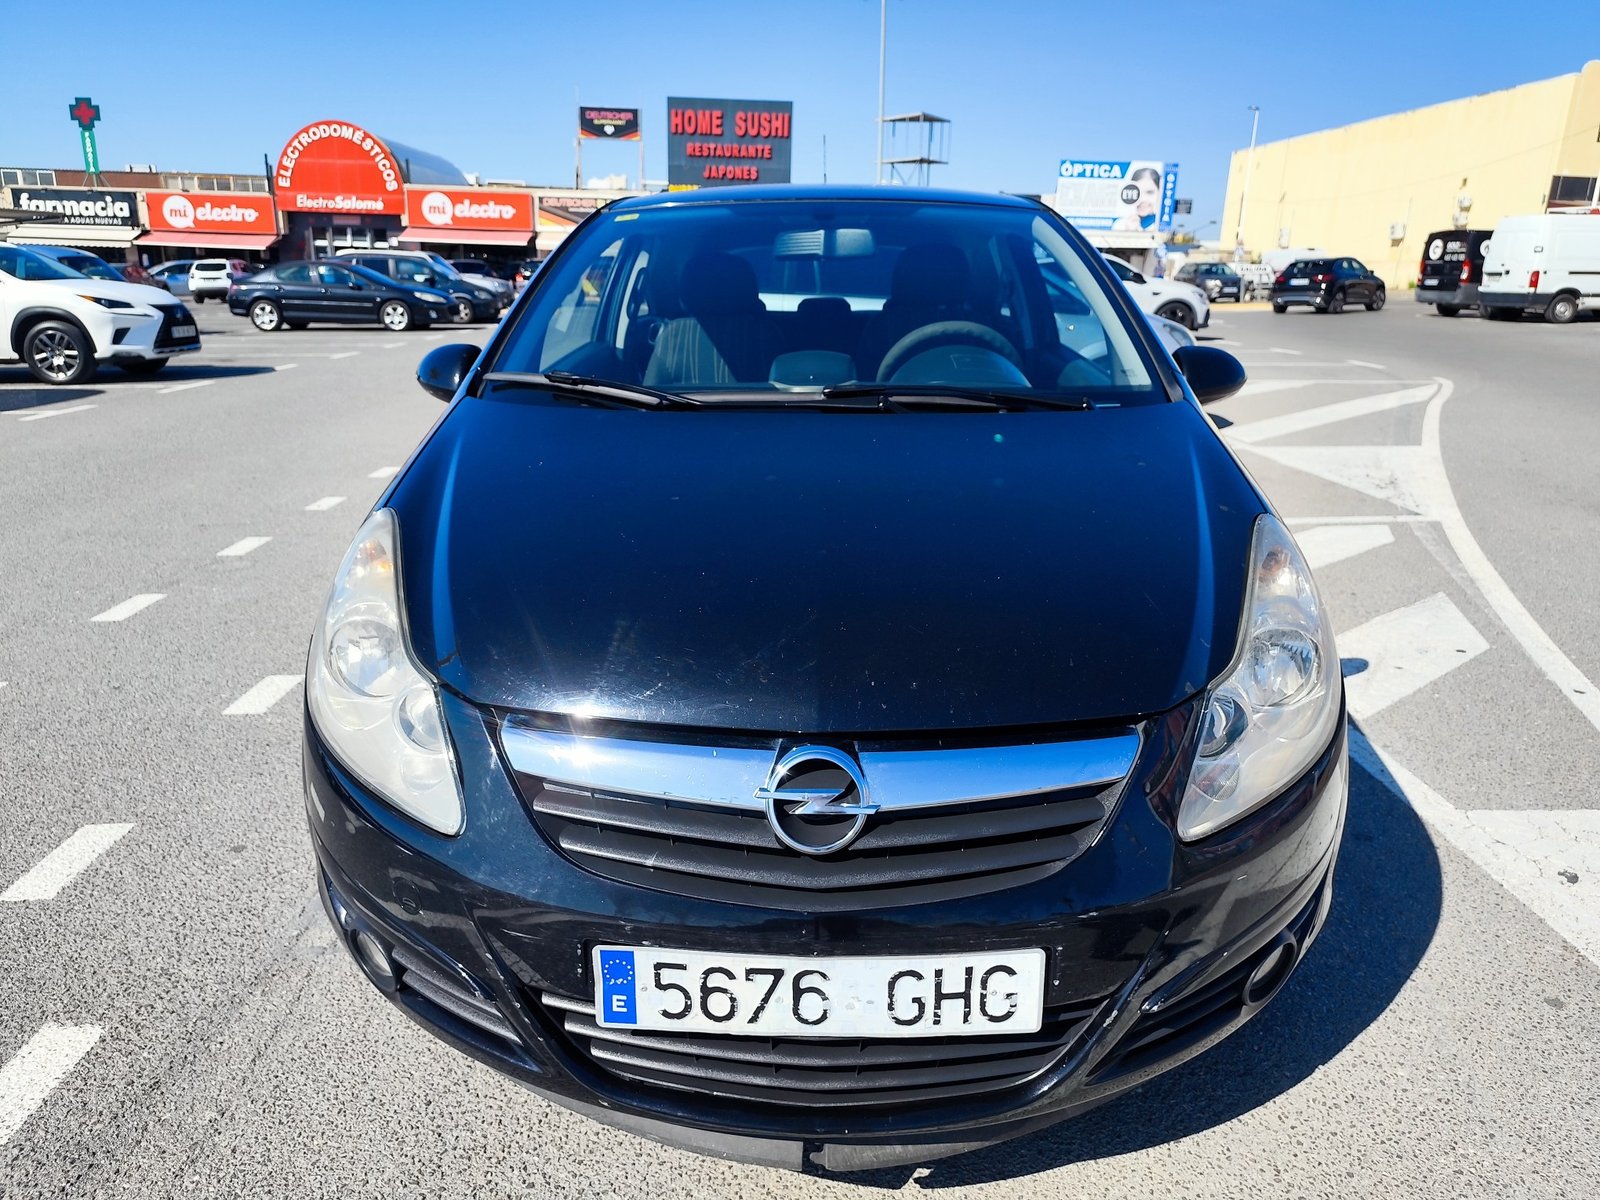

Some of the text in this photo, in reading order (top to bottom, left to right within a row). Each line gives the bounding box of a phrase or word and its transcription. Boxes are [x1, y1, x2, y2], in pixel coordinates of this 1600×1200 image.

[670, 108, 790, 138] HOME SUSHI
[278, 123, 398, 192] ELECTRODOMÉSTICOS
[686, 143, 772, 159] RESTAURANTE
[703, 165, 758, 180] JAPONES
[1060, 161, 1122, 178] ÓPTICA
[19, 192, 131, 218] farmacia
[169, 202, 259, 223] mi electro
[296, 194, 384, 211] ElectroSalomé
[428, 198, 516, 219] mi electro
[611, 961, 1019, 1027] E 5676 GHG
